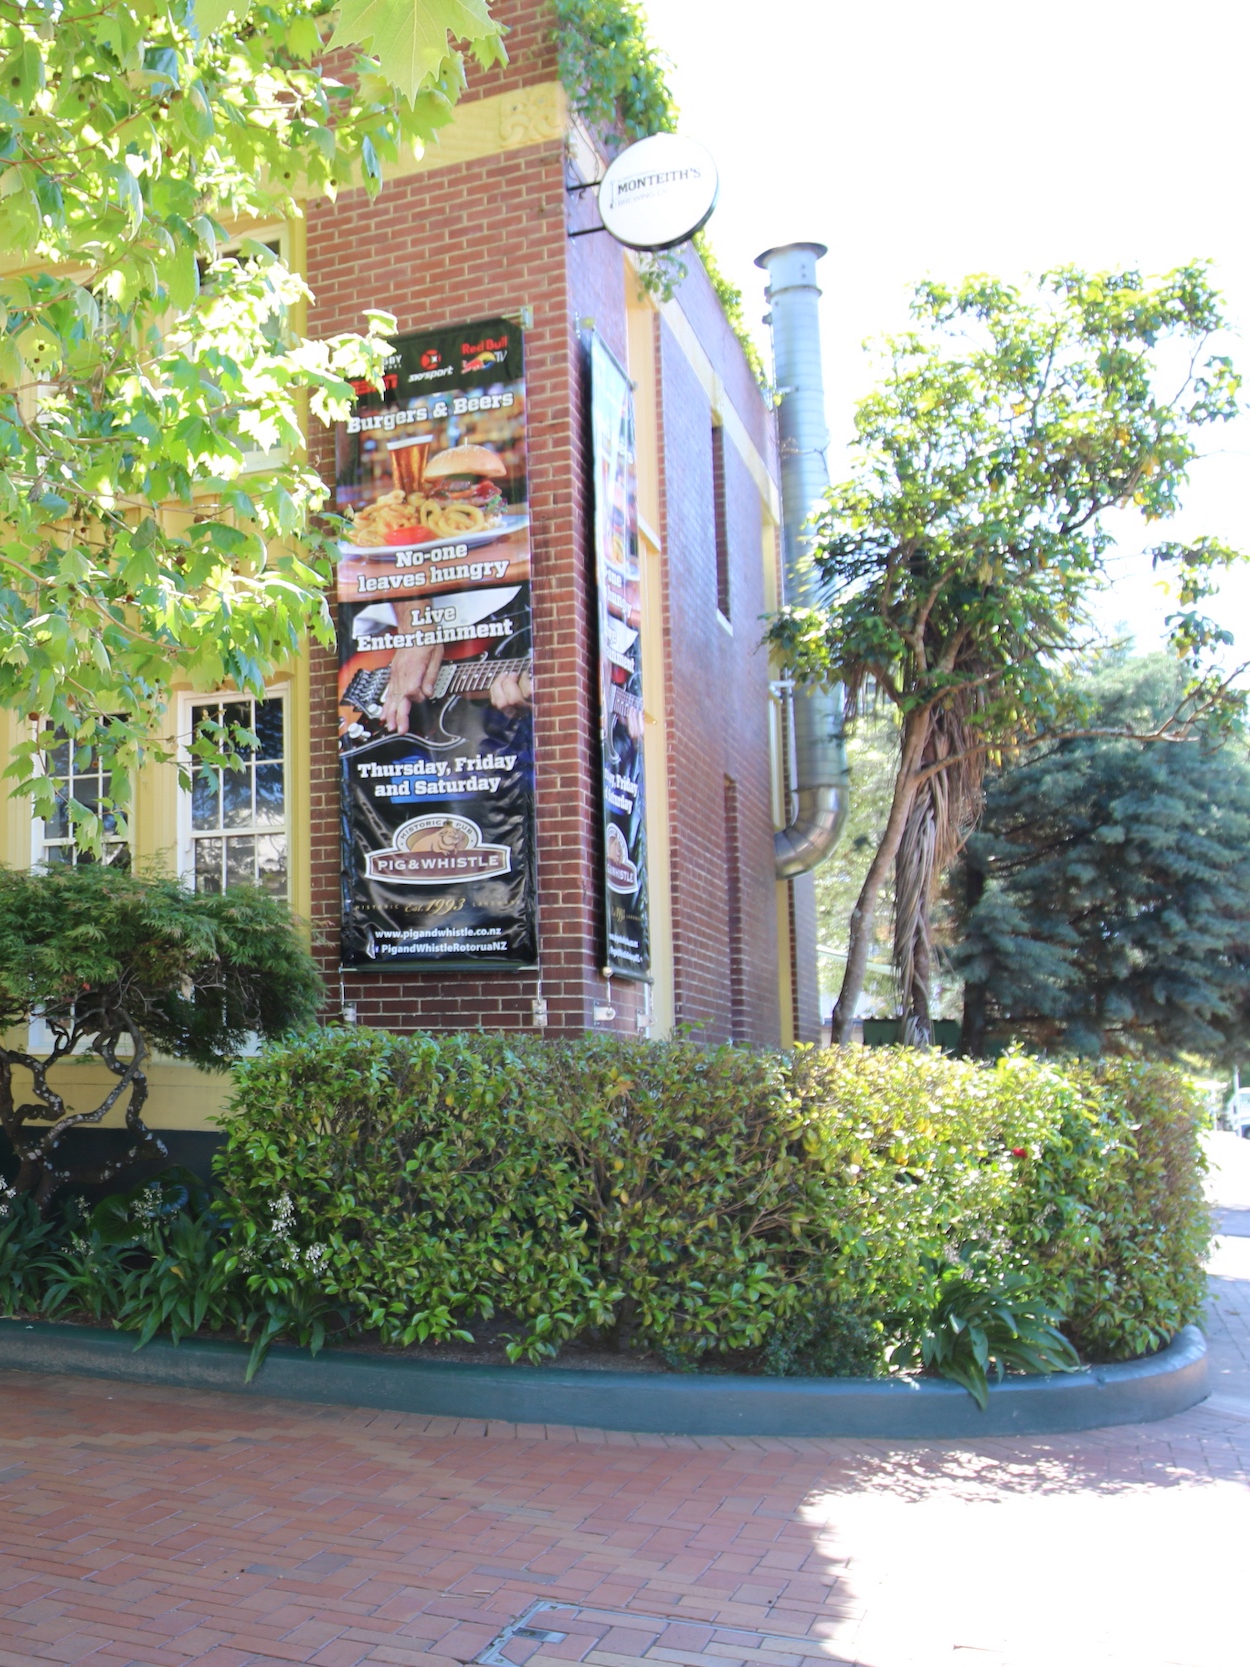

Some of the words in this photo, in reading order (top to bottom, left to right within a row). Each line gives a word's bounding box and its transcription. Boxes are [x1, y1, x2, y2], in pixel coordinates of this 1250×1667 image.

[617, 167, 702, 196] MONTEITH'S
[461, 340, 484, 356] Red
[485, 335, 508, 351] Bull
[493, 350, 508, 363] TV
[347, 406, 428, 434] Burgers
[433, 401, 448, 418] &
[453, 392, 514, 415] Beers
[395, 543, 468, 568] No-one
[357, 571, 426, 593] leaves
[430, 559, 510, 584] hungry
[410, 606, 457, 626] Live
[356, 618, 514, 652] Entertainment
[357, 759, 451, 778] Thursday,
[454, 753, 517, 772] Friday
[374, 780, 410, 797] and
[414, 775, 502, 795] Saturday
[401, 820, 442, 840] HISTORIC
[456, 822, 473, 835] PUB
[425, 897, 466, 916] 1993
[375, 928, 502, 940] www.pigandwhistle.co.nz
[381, 941, 508, 955] PigandWhistleRotoruaNZ
